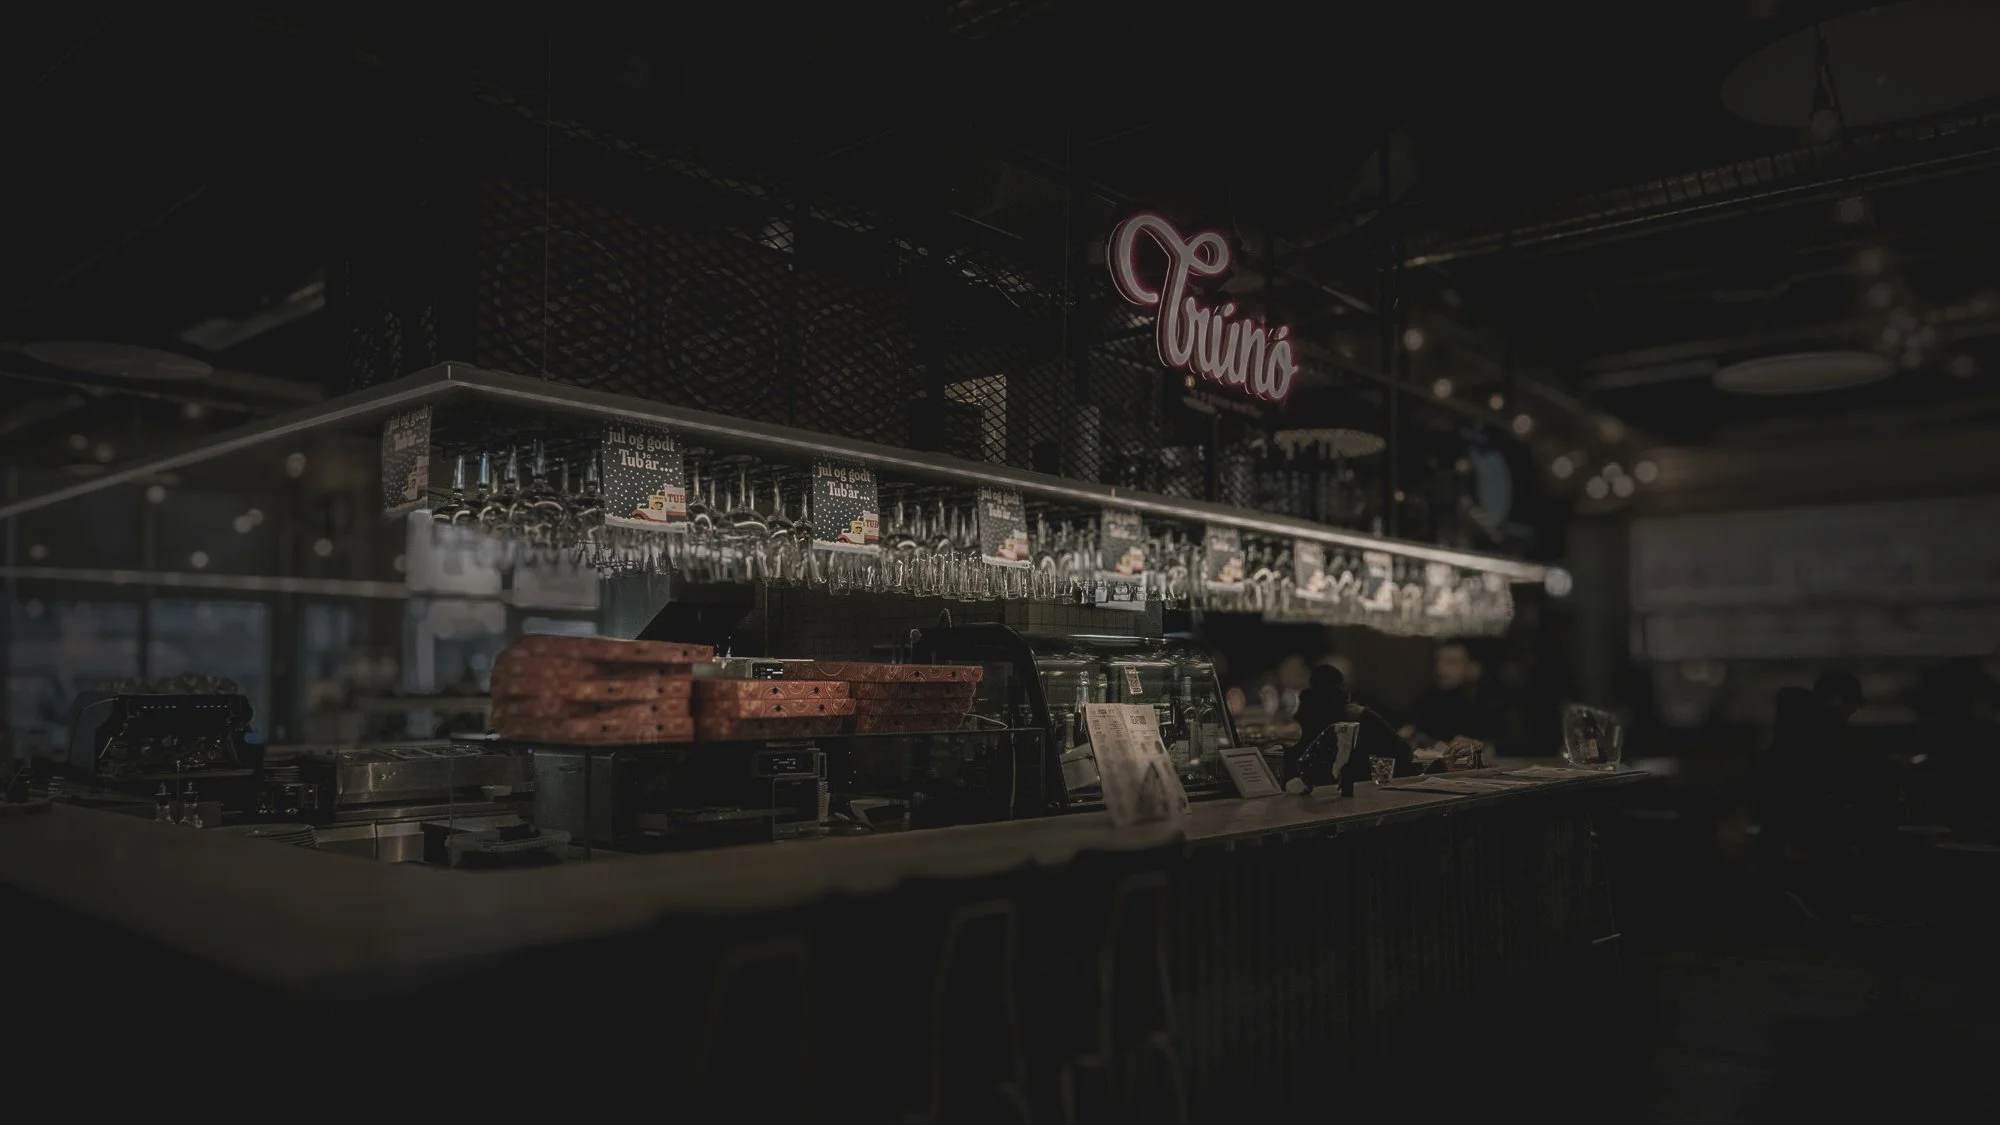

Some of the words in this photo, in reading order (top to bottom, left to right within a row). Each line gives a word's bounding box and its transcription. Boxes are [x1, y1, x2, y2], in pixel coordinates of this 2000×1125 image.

[607, 427, 626, 445] jul
[628, 434, 644, 450] og
[647, 435, 675, 452] godt
[817, 462, 832, 478] jul
[834, 467, 847, 482] og
[849, 467, 871, 483] godt
